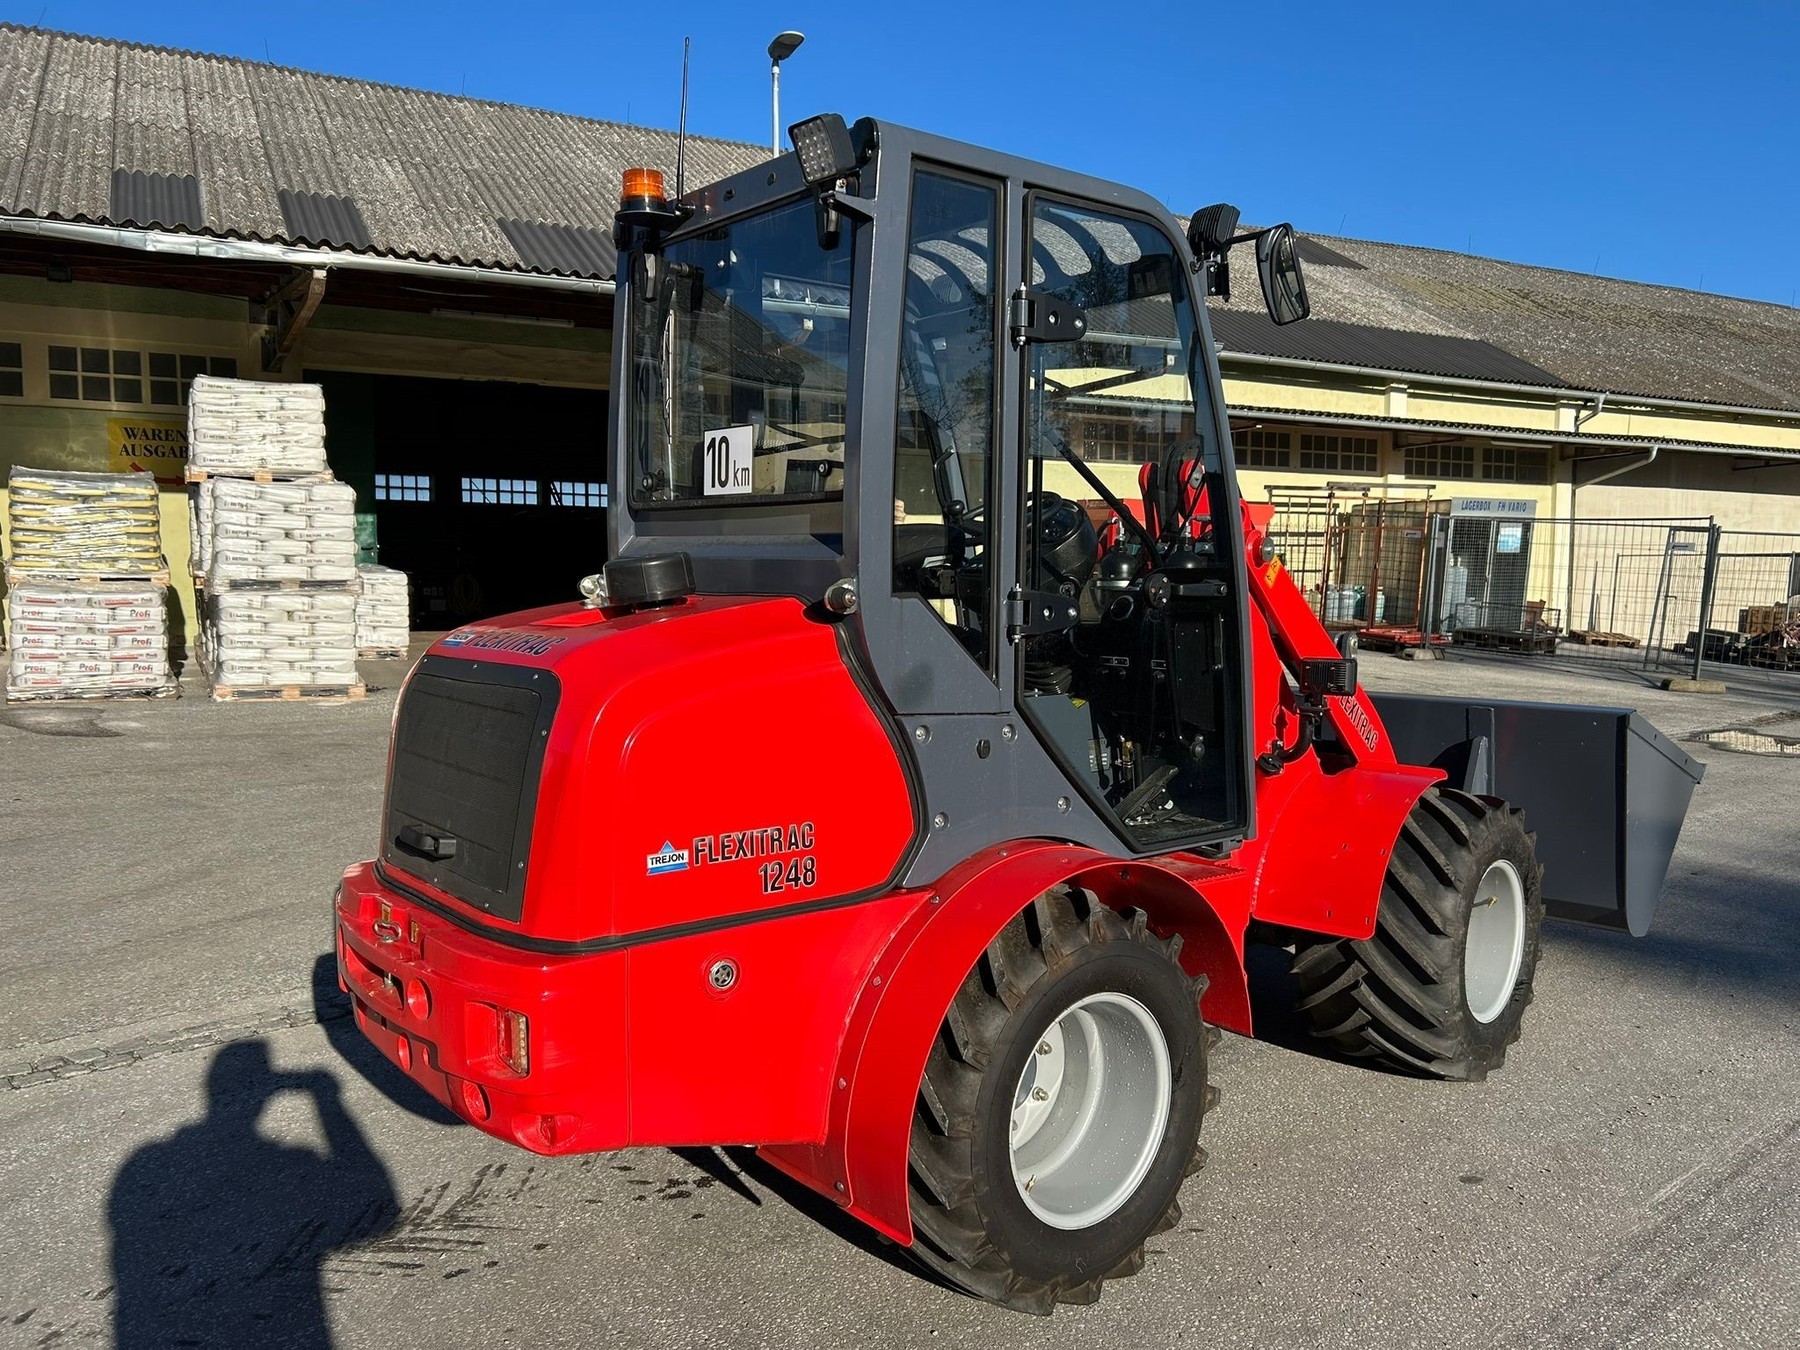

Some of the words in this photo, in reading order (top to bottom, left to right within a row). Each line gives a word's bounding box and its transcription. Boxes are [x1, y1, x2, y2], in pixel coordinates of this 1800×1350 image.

[123, 426, 187, 443] WAREN
[120, 443, 189, 459] AUSGAB
[706, 435, 730, 489] 10
[732, 459, 750, 487] km
[1461, 500, 1491, 512] LAGERBOX
[1508, 502, 1527, 513] VARIO
[130, 609, 150, 618] Profi
[131, 637, 152, 646] Profi
[79, 663, 100, 673] Profi
[132, 663, 153, 672] Profi
[1339, 696, 1378, 752] LEXITRAC
[650, 852, 685, 866] TREJON
[693, 822, 815, 866] FLEXITRAC
[759, 856, 816, 894] 1248
